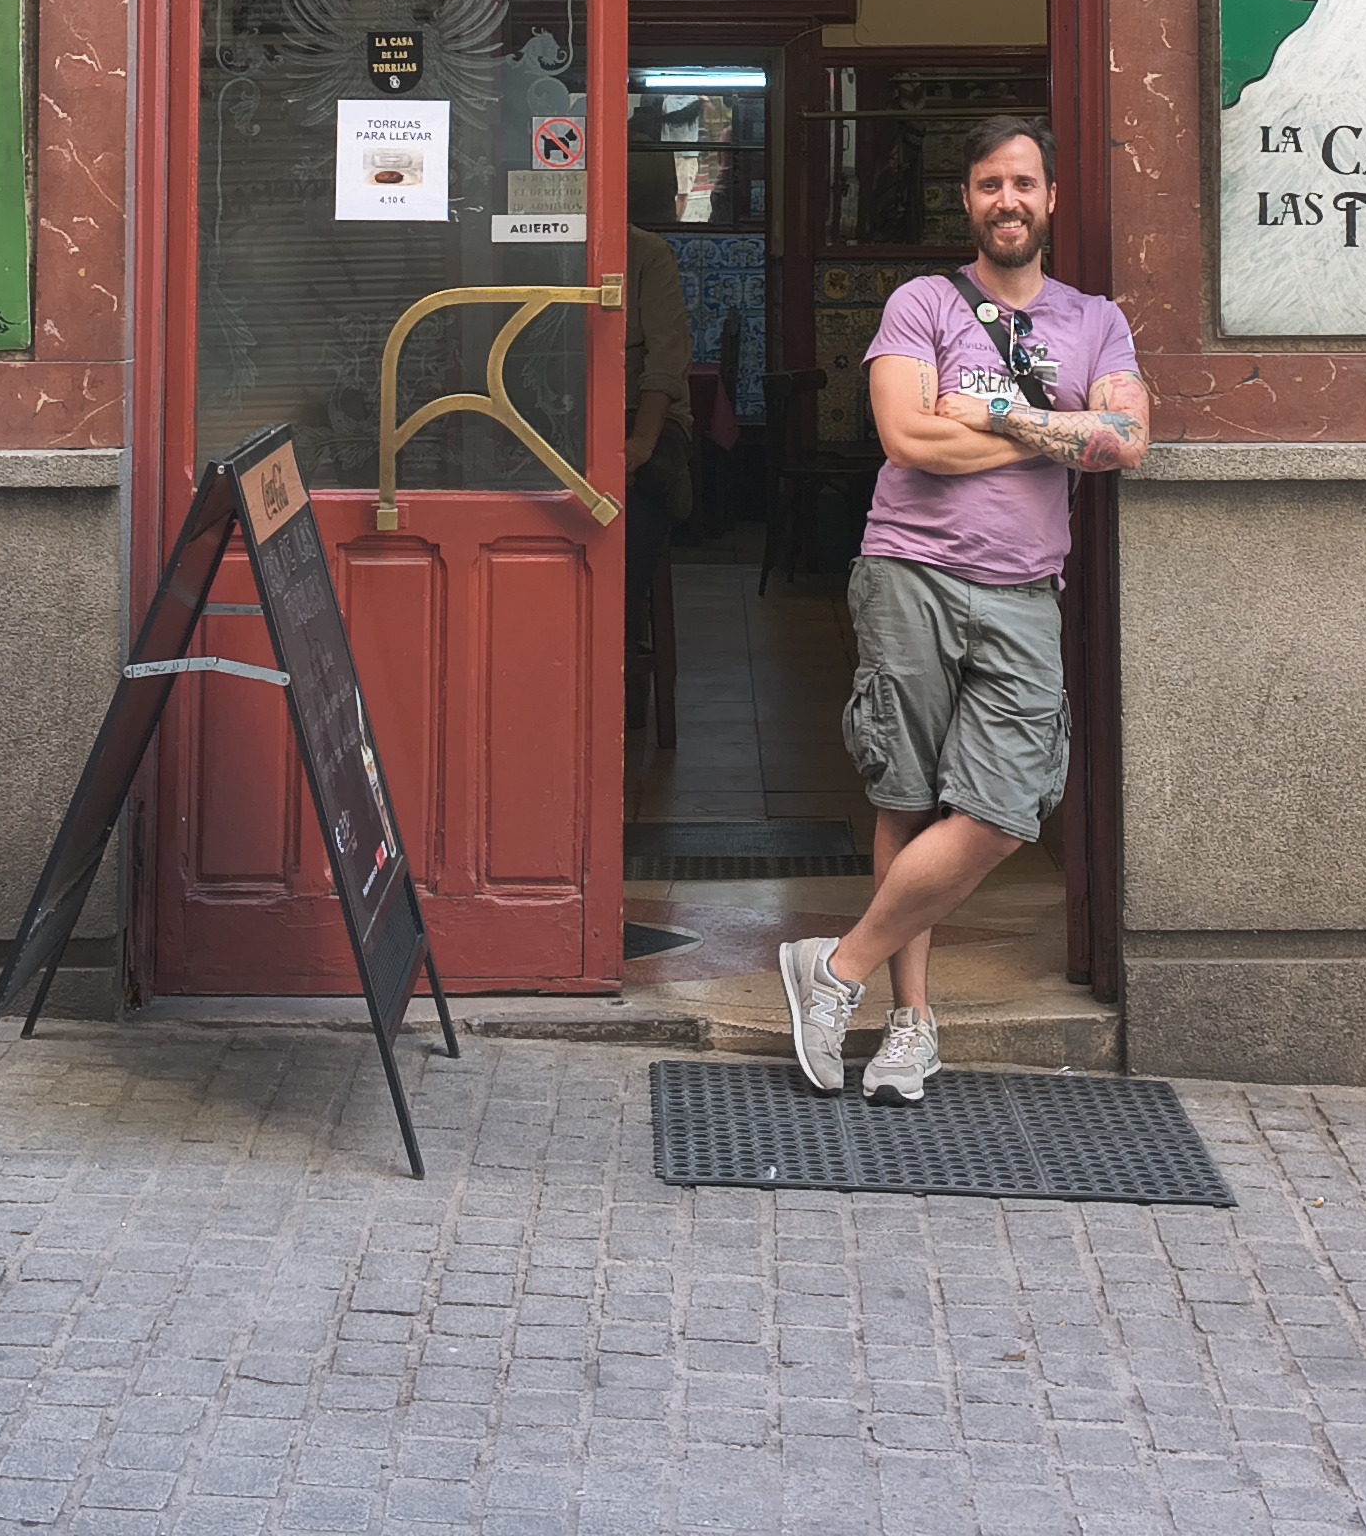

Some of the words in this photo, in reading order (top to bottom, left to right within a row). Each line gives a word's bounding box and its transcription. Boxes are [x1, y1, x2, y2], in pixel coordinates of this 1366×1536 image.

[375, 37, 387, 46] LA
[390, 37, 413, 46] CASA
[381, 51, 392, 59] DE
[394, 51, 408, 59] LAS
[372, 63, 417, 72] TORRIJAS
[367, 120, 421, 129] TORRIJAS
[356, 131, 386, 141] PARA
[389, 131, 432, 141] LLEVAR
[1260, 125, 1304, 154] LA
[1257, 192, 1324, 226] LAS
[510, 222, 570, 234] ABIERTO
